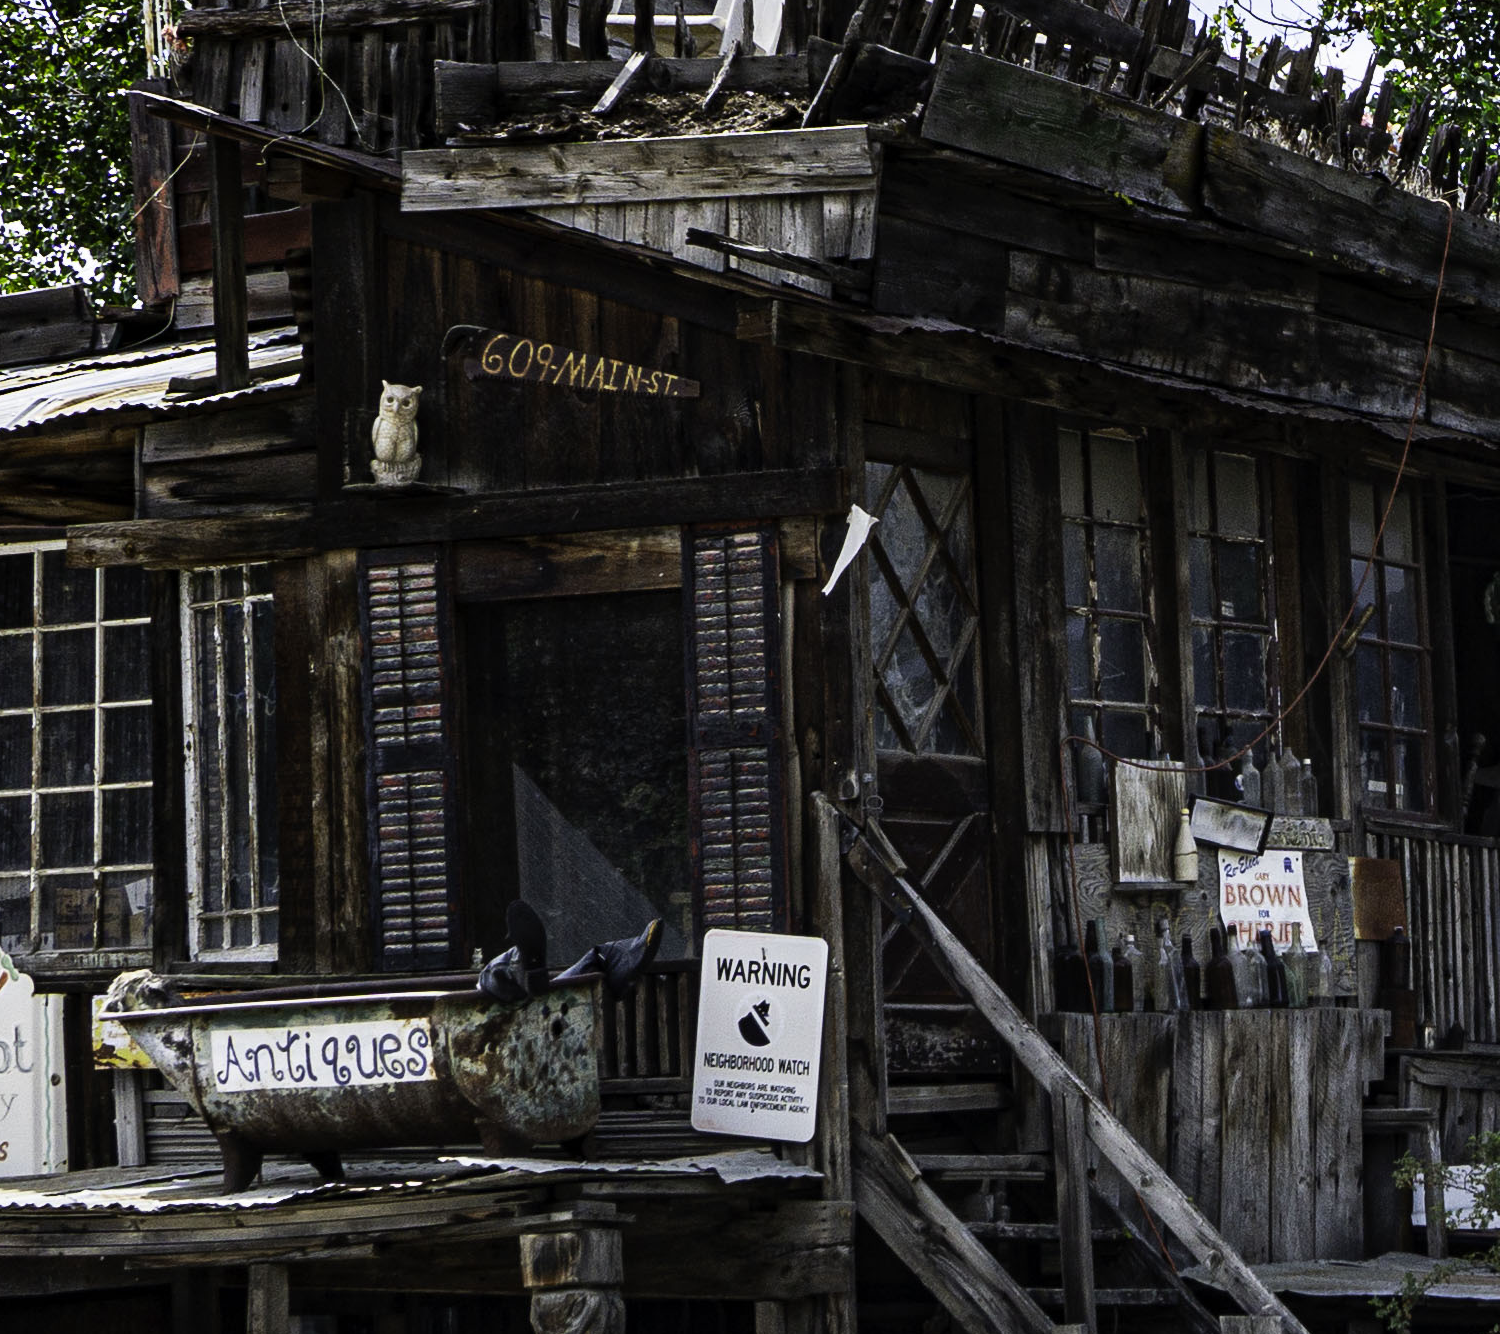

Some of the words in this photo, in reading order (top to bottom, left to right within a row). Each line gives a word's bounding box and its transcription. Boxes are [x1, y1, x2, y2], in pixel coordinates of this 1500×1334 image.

[1224, 883, 1302, 907] BROWN
[1226, 920, 1304, 944] HERIF
[716, 957, 811, 989] WARNING
[217, 1027, 429, 1085] Antiques
[703, 1052, 775, 1073] NEIGHBORHOOD
[778, 1059, 810, 1076] WATCH
